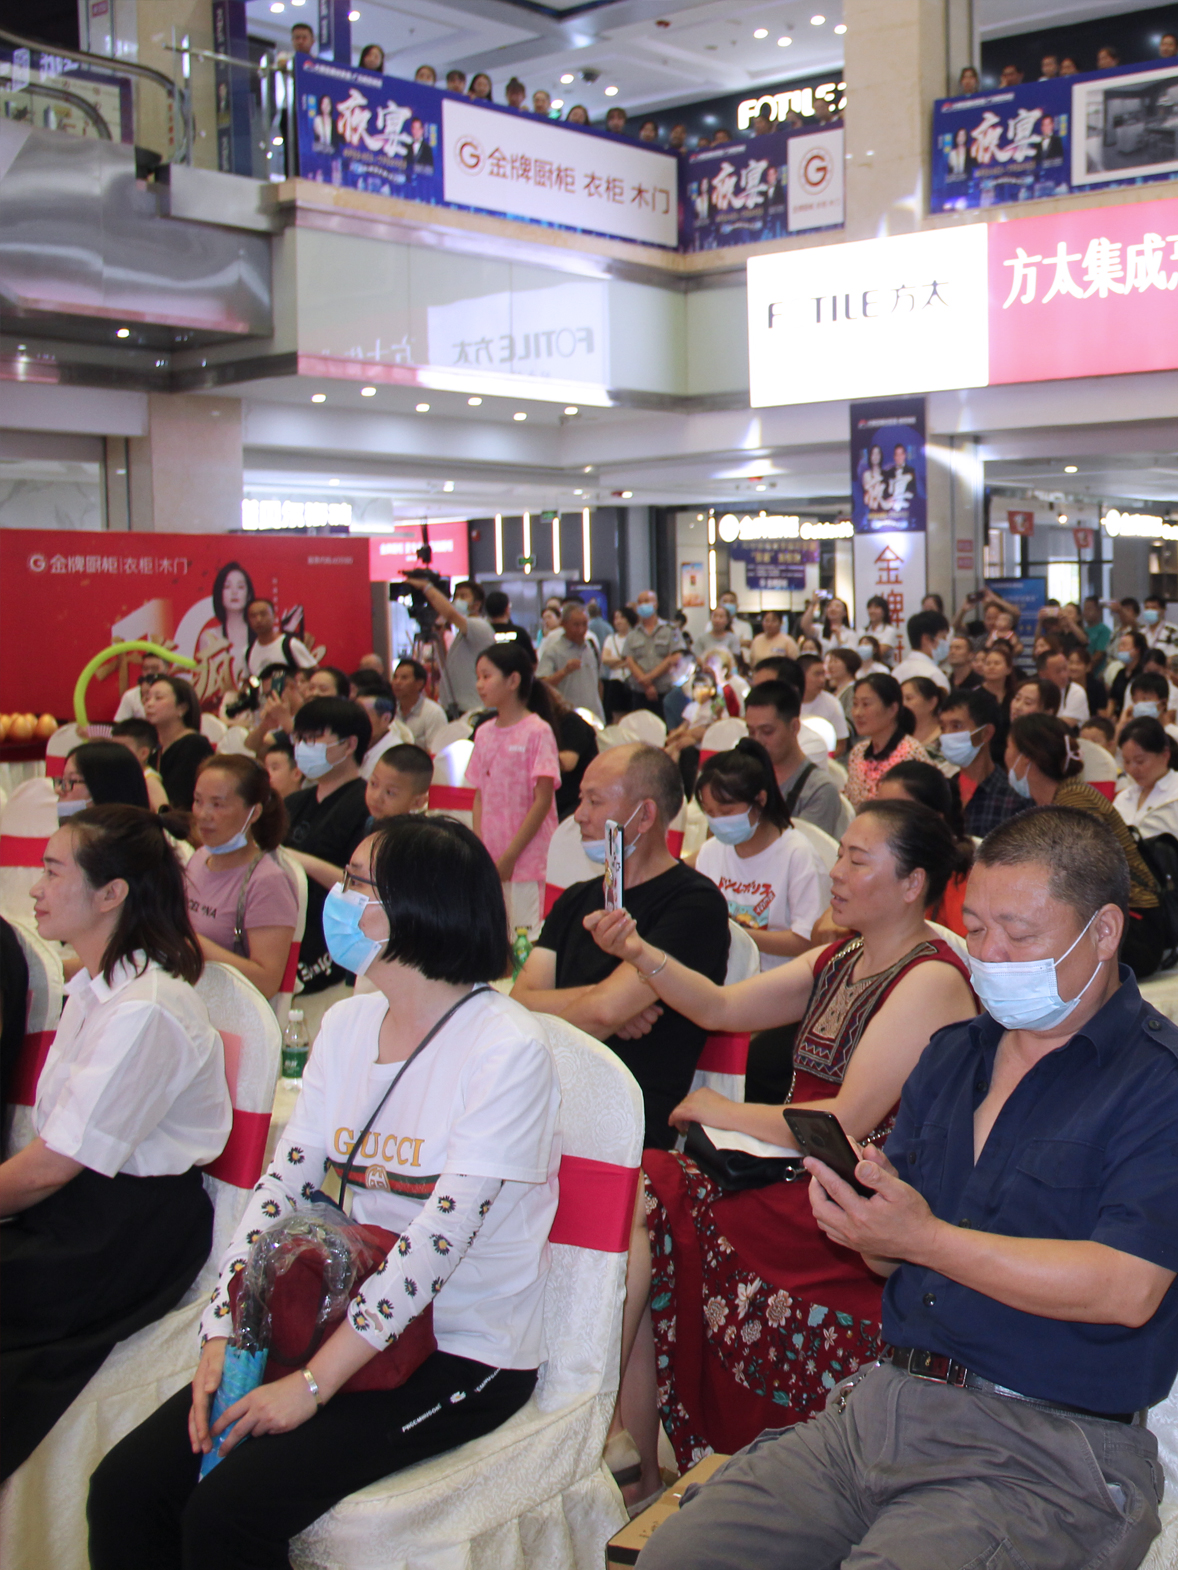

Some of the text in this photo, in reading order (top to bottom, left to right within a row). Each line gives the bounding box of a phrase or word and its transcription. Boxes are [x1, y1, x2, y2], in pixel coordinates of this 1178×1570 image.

[336, 87, 415, 157] 夜宴
[970, 108, 1043, 163] 夜宴
[487, 147, 671, 214] 金牌厨柜 衣柜 木门
[711, 160, 769, 211] 夜宴
[768, 290, 879, 329] FTILE
[333, 1127, 425, 1167] GUCCI
